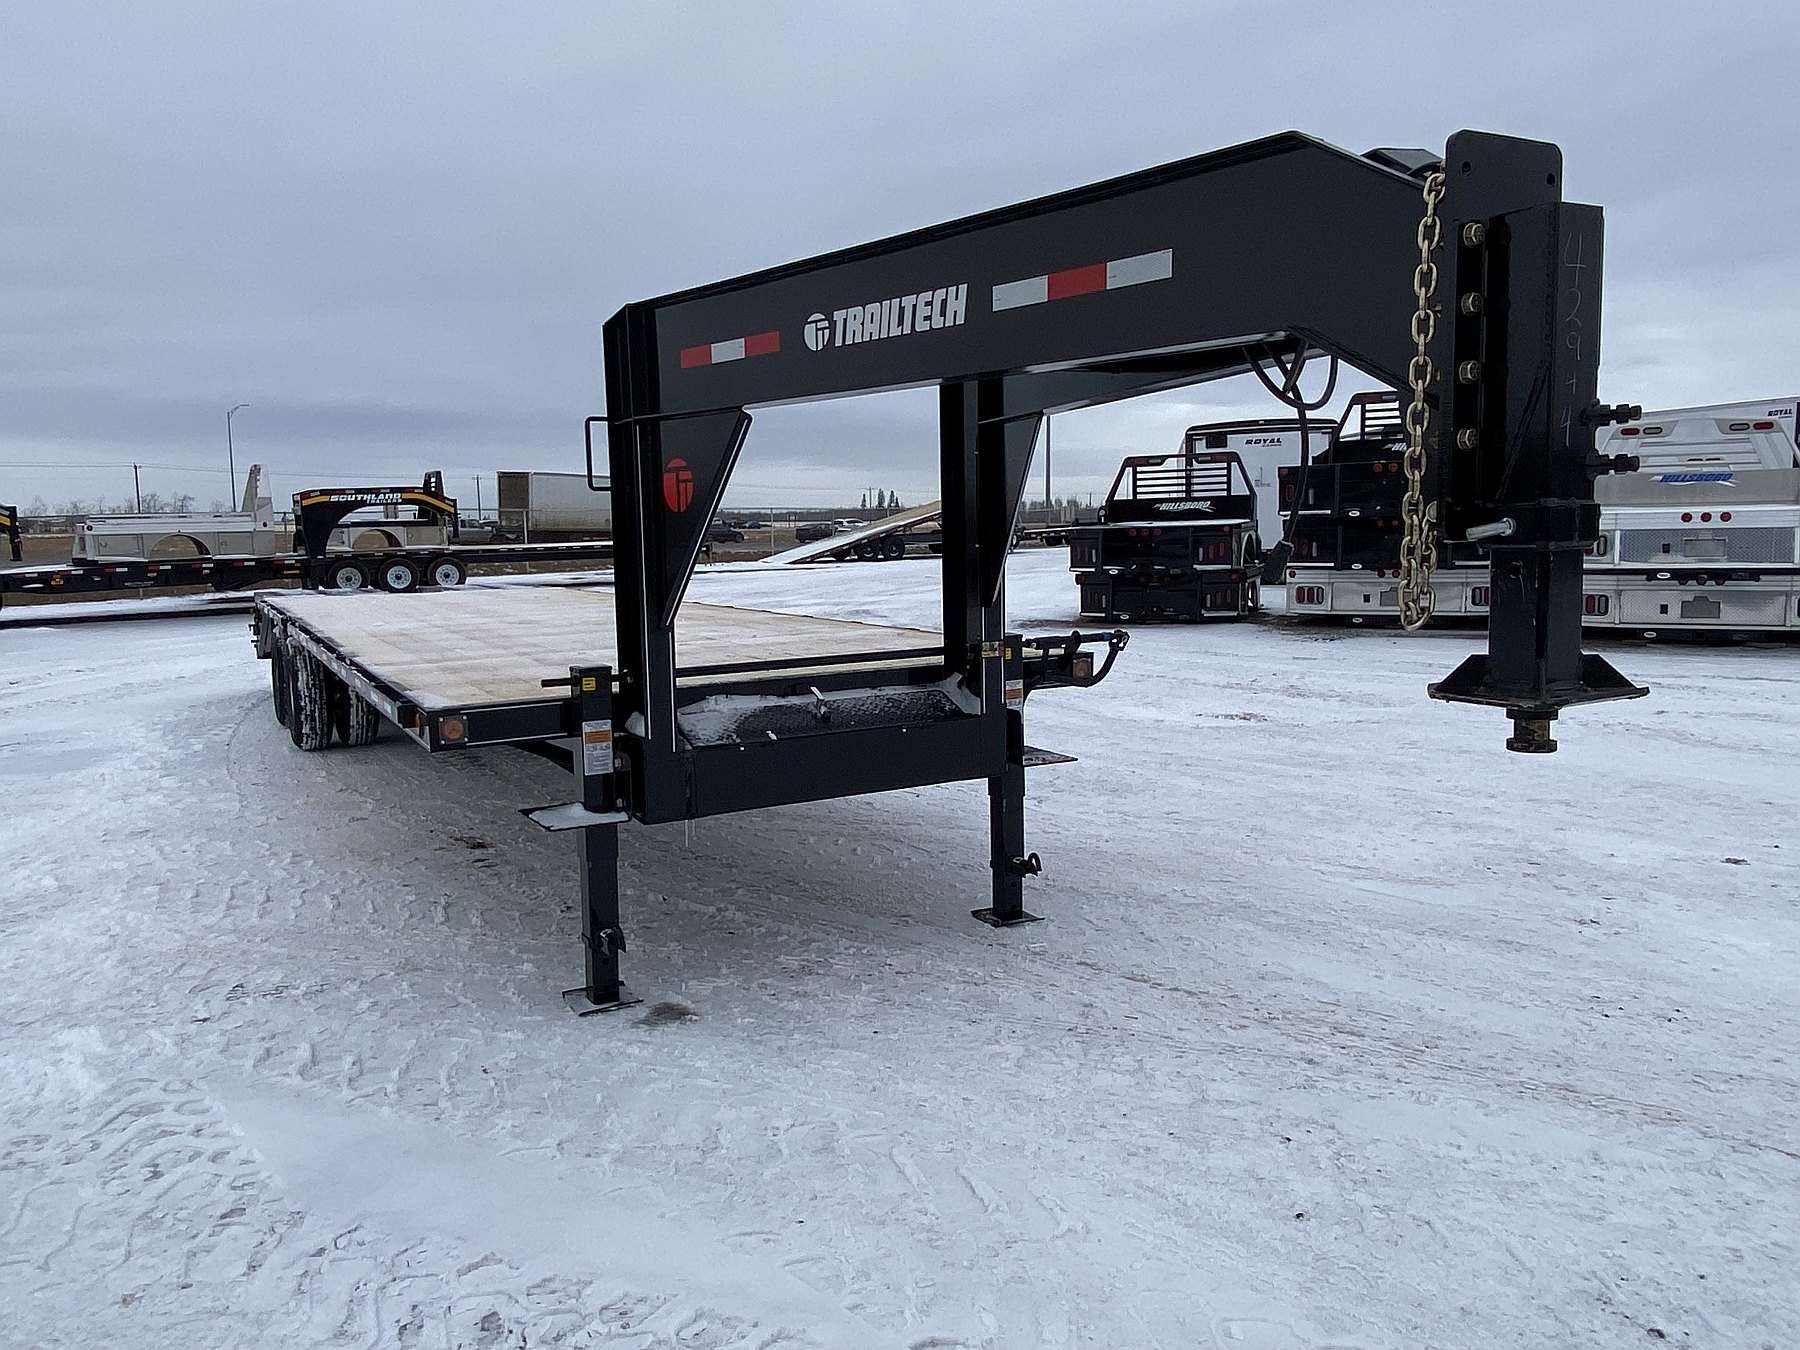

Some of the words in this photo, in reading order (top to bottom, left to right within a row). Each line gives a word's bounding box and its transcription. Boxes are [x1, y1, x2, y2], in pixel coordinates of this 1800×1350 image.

[833, 283, 969, 347] TRAILTECH
[1245, 437, 1282, 445] ROYAL
[1660, 473, 1733, 482] HILLSBORO
[330, 493, 401, 502] SOUTHLAND
[1159, 501, 1211, 510] HILLSBORO
